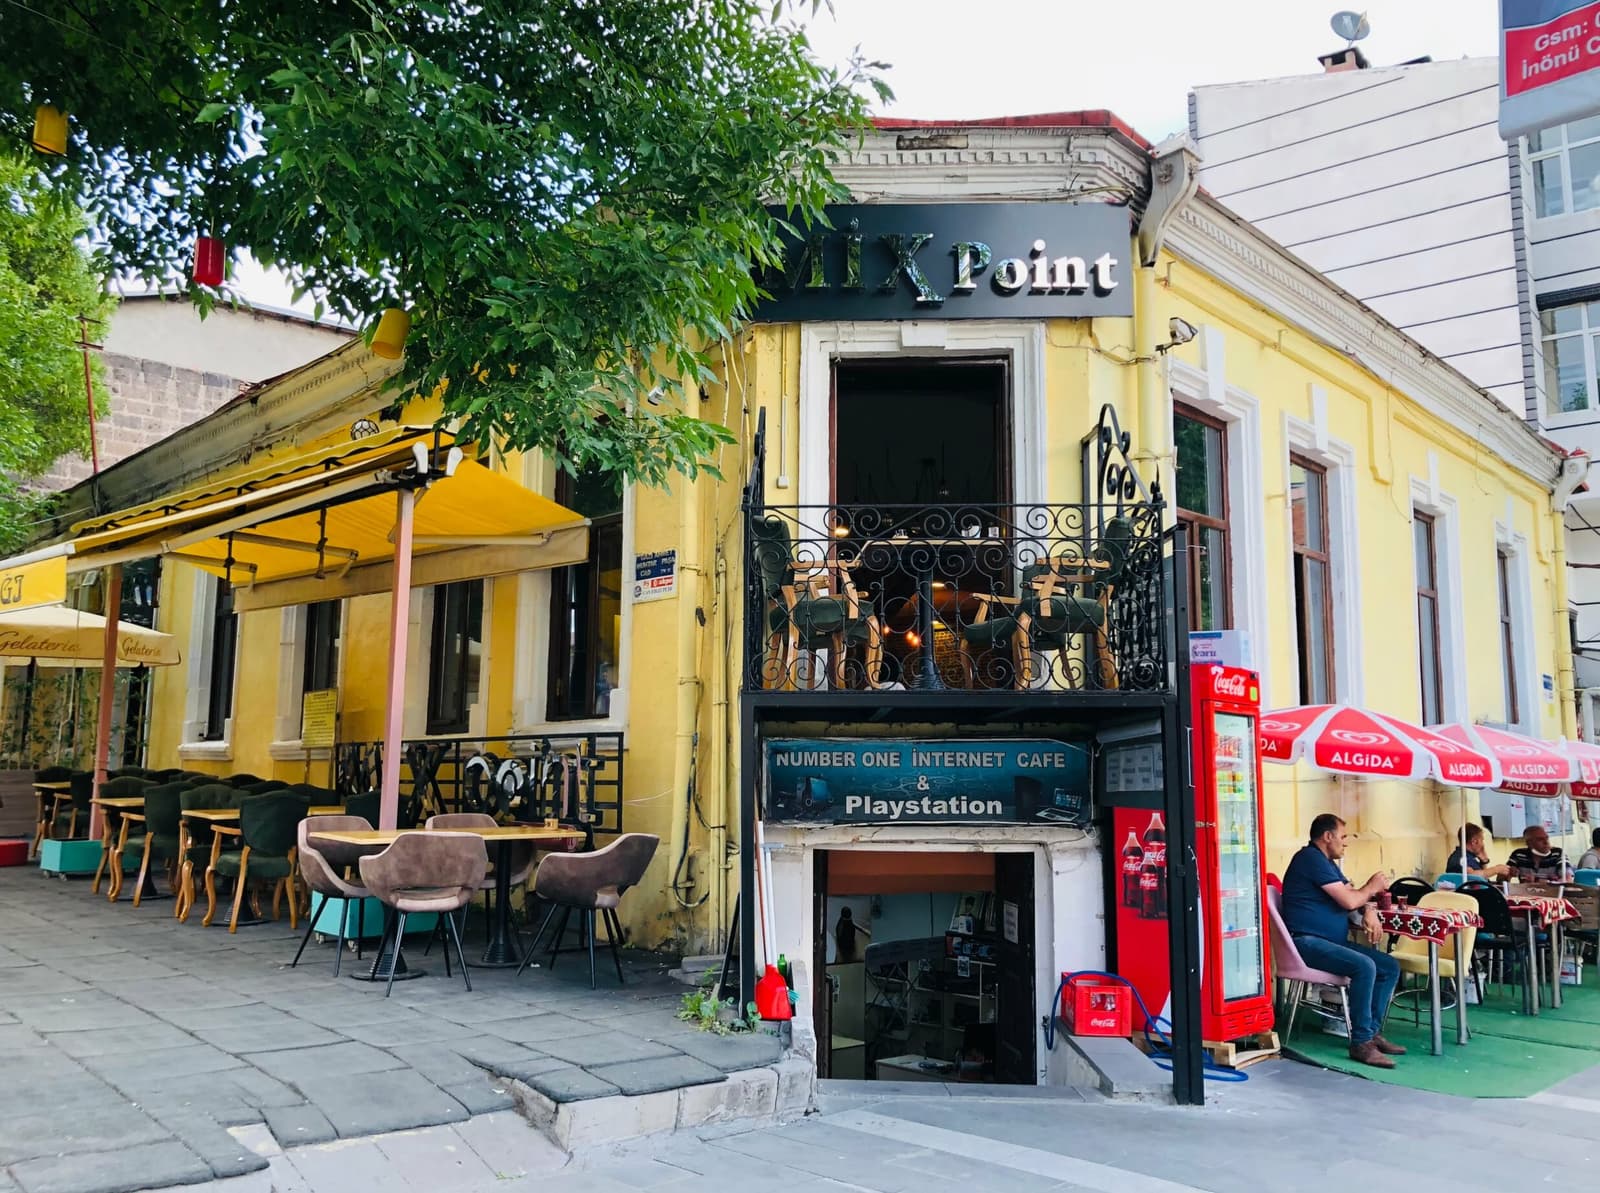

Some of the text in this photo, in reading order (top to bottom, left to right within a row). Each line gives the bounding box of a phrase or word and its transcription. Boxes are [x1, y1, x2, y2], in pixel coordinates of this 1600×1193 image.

[1535, 21, 1588, 51] Gsm:
[1522, 44, 1580, 80] İnönü
[952, 239, 1119, 290] Point
[775, 748, 1065, 768] NUMBER ONE İNTERNET CAFE
[917, 775, 930, 790] &
[845, 796, 1003, 819] Playstation
